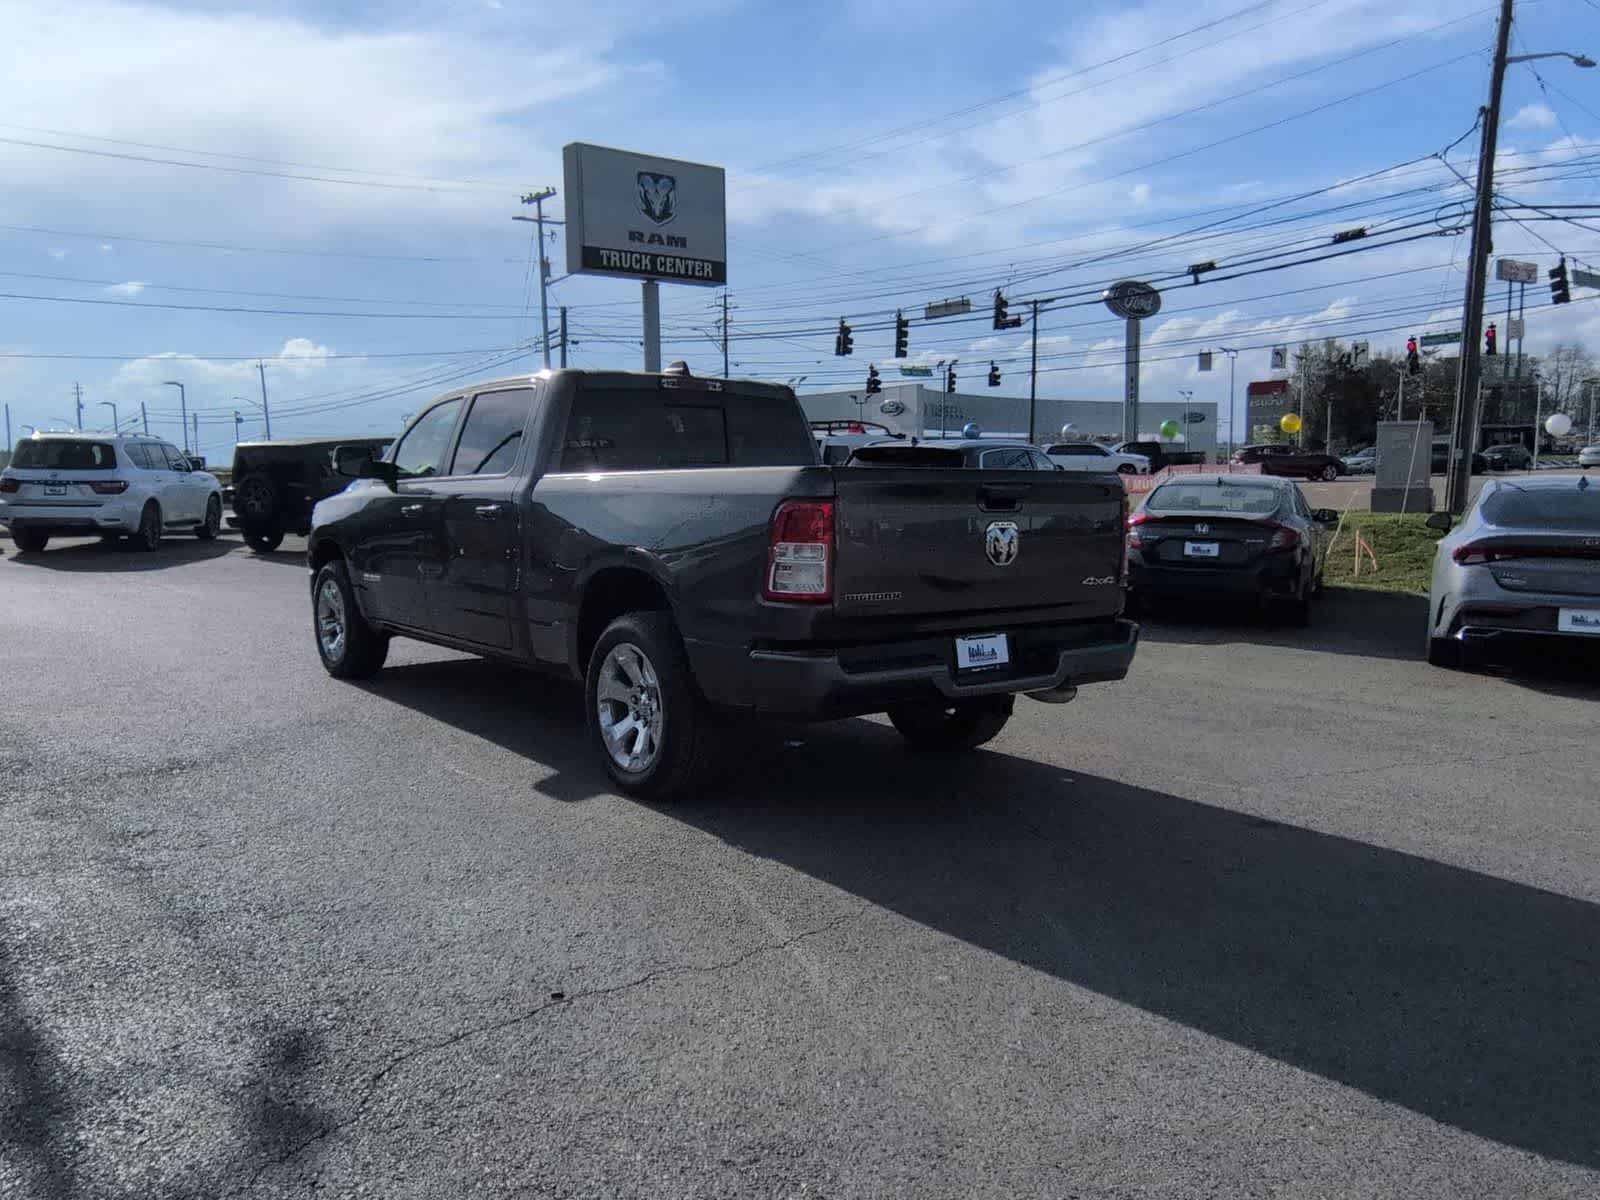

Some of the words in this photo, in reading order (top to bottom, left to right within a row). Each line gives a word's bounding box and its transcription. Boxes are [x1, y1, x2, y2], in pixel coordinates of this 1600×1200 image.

[628, 230, 687, 249] RAM
[600, 249, 652, 270] TRUCK
[656, 256, 713, 278] CENTER
[1124, 287, 1154, 312] Ford
